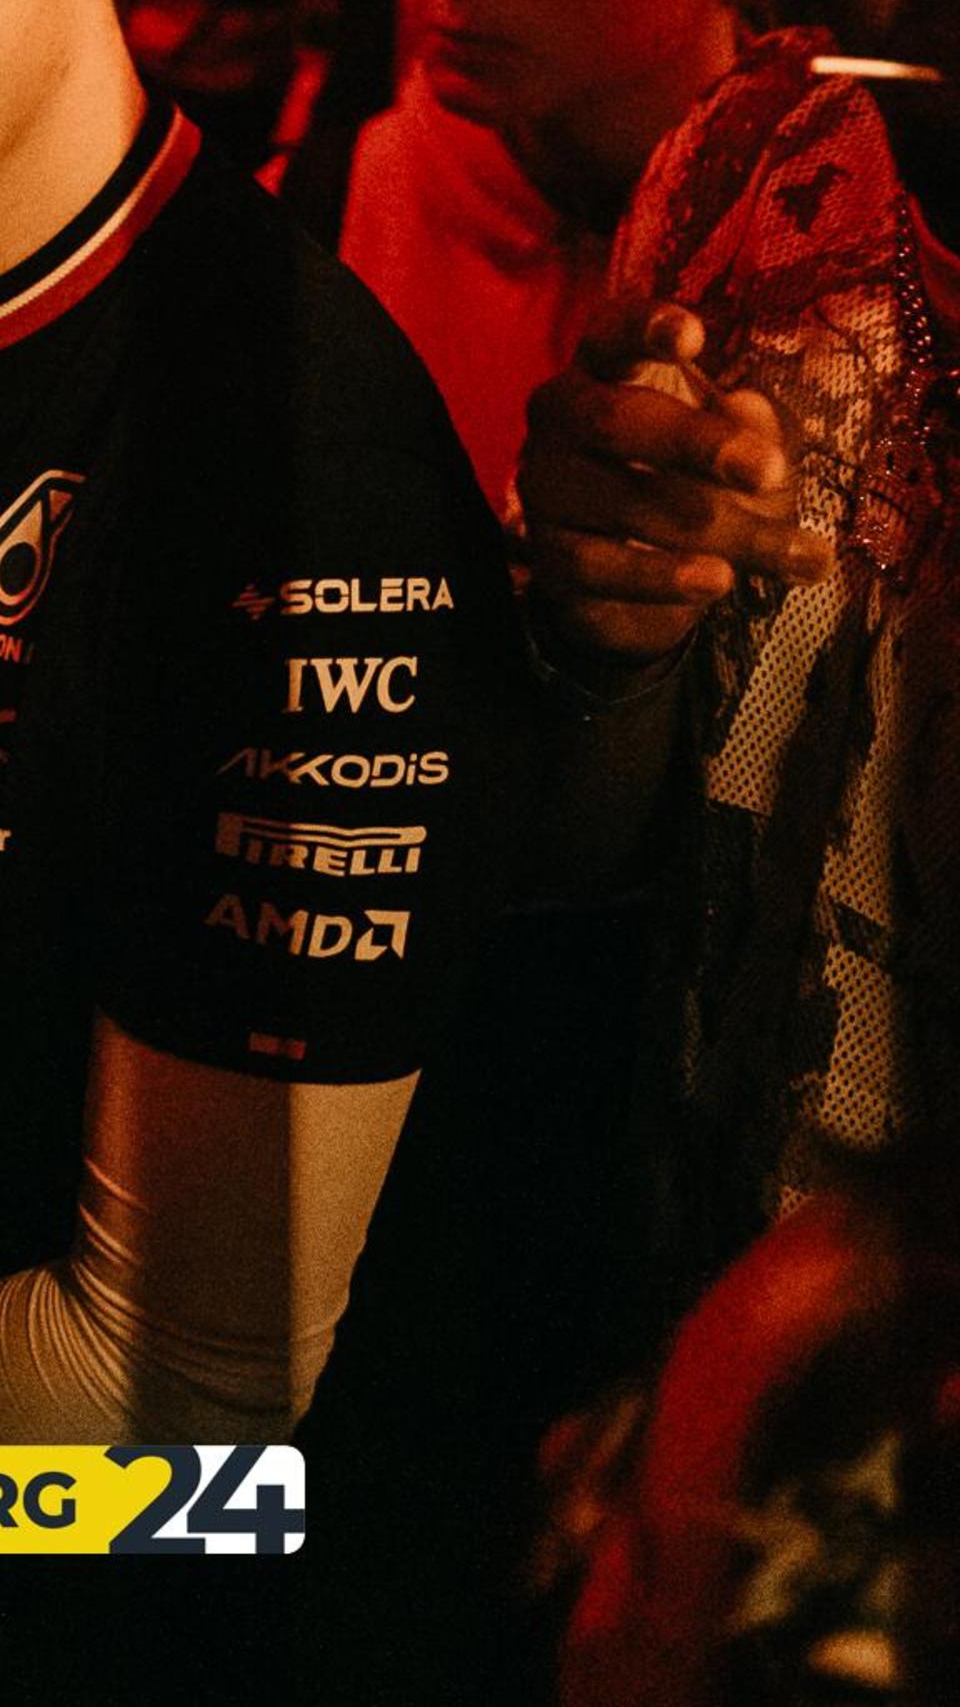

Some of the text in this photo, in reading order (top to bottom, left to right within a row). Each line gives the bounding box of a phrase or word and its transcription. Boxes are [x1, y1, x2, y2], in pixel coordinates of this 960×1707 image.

[280, 576, 455, 615] SOLERA
[281, 655, 418, 714] IWC
[214, 810, 428, 878] PIRELLI
[203, 893, 354, 959] AMD
